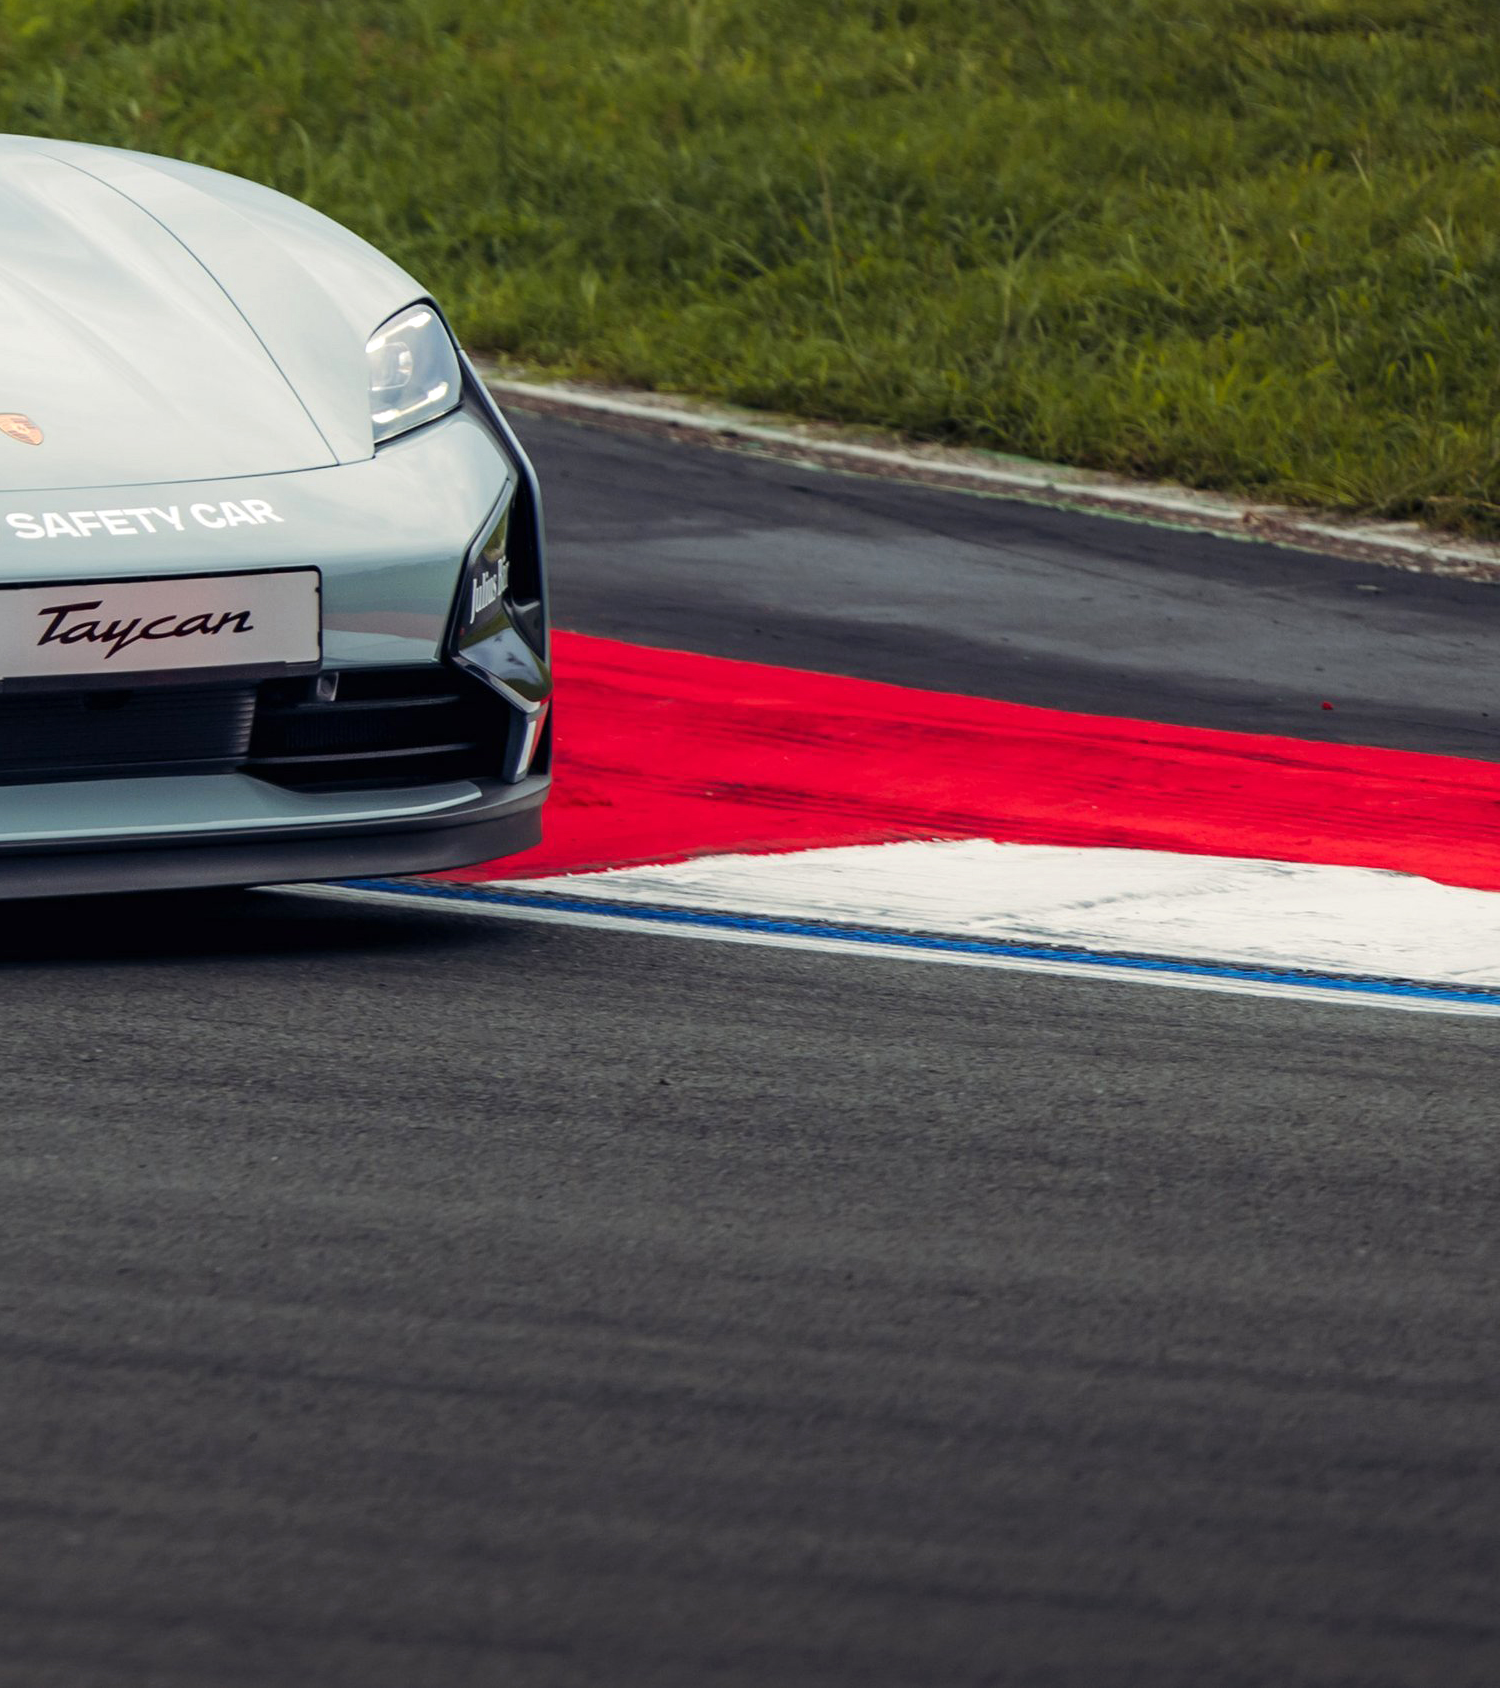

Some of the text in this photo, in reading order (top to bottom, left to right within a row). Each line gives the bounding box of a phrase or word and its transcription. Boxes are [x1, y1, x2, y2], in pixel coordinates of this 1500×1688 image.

[5, 505, 185, 540] SAFETY
[190, 498, 285, 530] CAR
[37, 600, 254, 660] Taycan
